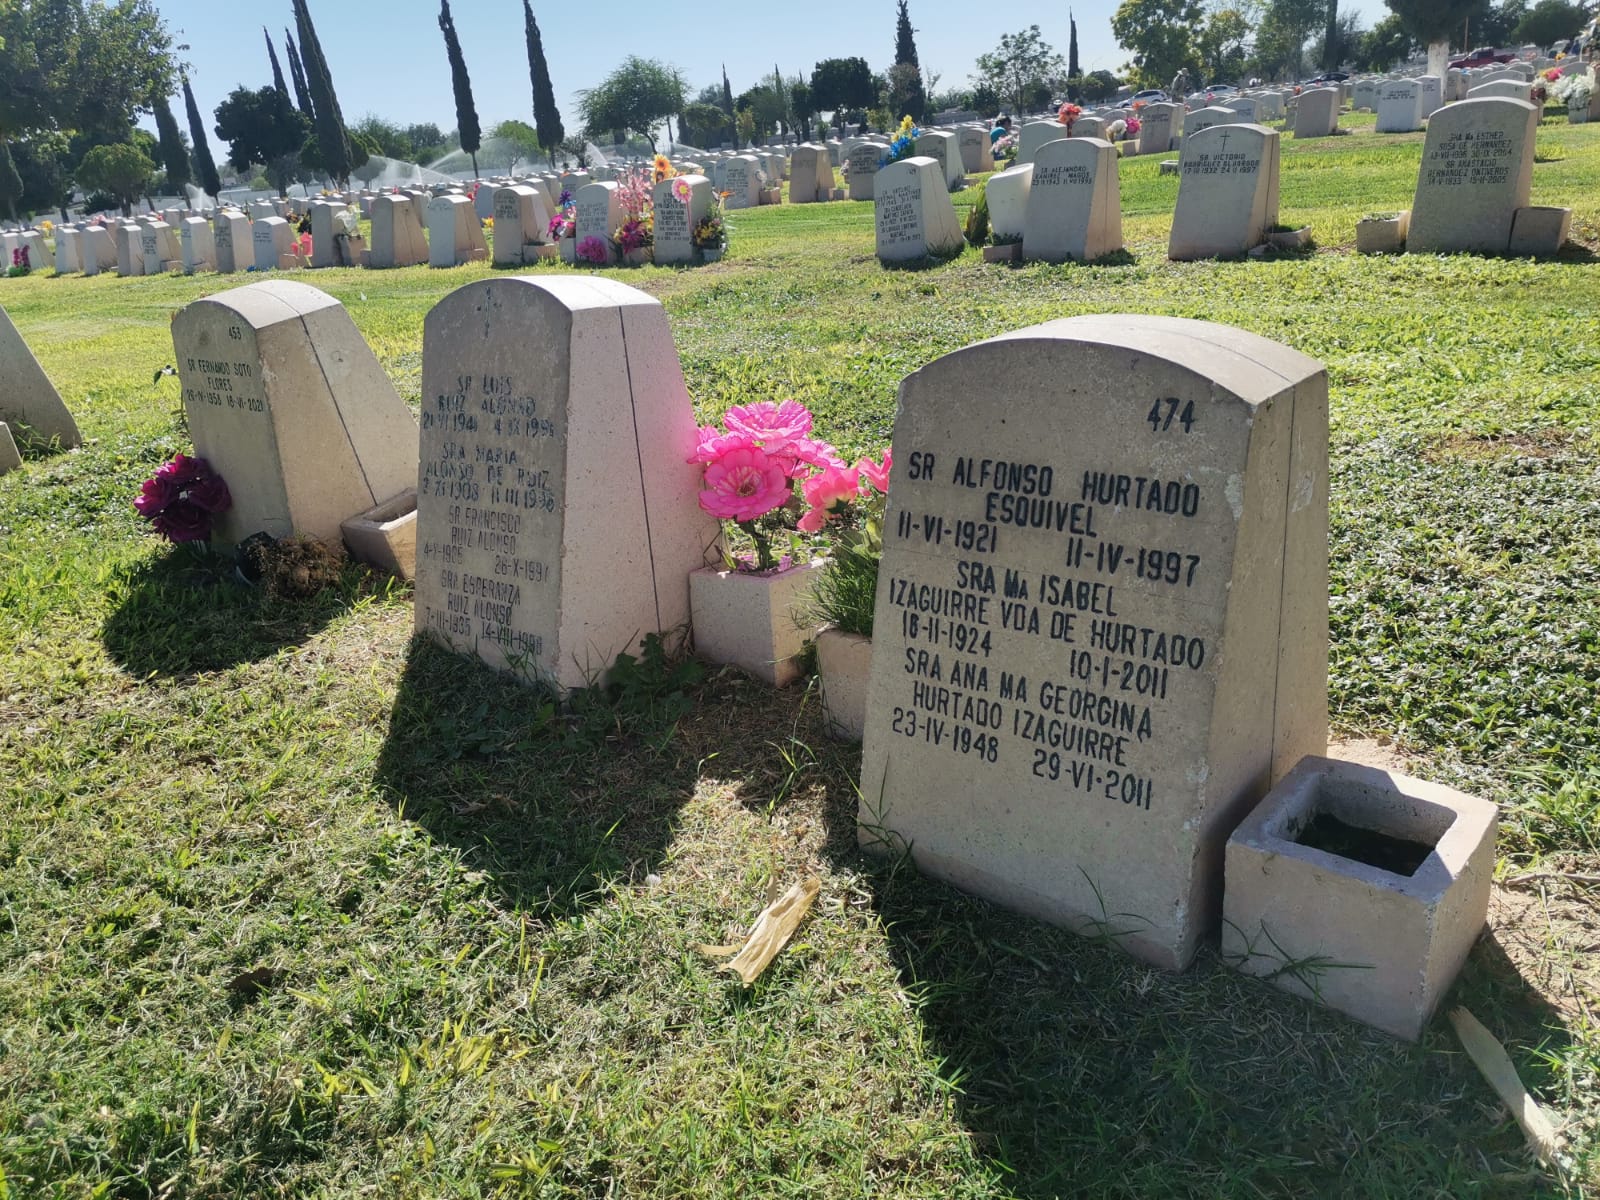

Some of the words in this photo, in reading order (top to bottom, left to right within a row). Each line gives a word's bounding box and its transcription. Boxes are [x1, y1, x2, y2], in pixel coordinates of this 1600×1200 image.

[228, 326, 242, 340] 453
[187, 358, 196, 372] SR
[198, 359, 231, 376] FERNANDO
[233, 361, 252, 377] SOTO
[207, 377, 233, 392] FLORES
[438, 395, 466, 412] RUIZ
[1147, 397, 1196, 433] 474
[442, 442, 465, 460] SRA
[475, 445, 518, 465] MARIA
[425, 460, 474, 482] ALONSO
[487, 465, 504, 485] DE
[517, 468, 551, 492] RUIZ
[908, 451, 936, 481] SR
[952, 456, 1054, 497] ALFONSO
[1081, 470, 1201, 518] HURTADO
[449, 504, 461, 525] SR
[465, 507, 521, 535] FRANCISCO
[985, 492, 1098, 537] ESQUIVEL
[451, 526, 473, 548] RUIZ
[478, 530, 517, 556] ALONSO
[441, 569, 459, 589] SRA
[463, 573, 521, 607] ESPERANZA
[956, 561, 997, 595] SRA
[1039, 574, 1118, 618] ISABEL
[447, 593, 469, 616] RUIZ
[474, 599, 513, 627] ALONSO
[889, 577, 990, 627] IZAGUIRRE
[1000, 600, 1040, 635] VDA
[1050, 610, 1077, 645] DE
[1090, 619, 1206, 670] HURTADO
[904, 647, 942, 681] SRA
[950, 659, 989, 692] ANA
[999, 671, 1028, 702] MA
[1039, 681, 1152, 743] GEORGINA
[913, 681, 1002, 731] HURTADO
[1013, 709, 1130, 768] IZAGUIRRE
[892, 707, 999, 764] 23-IV-1948
[1032, 749, 1152, 810] 29-VI-2011
